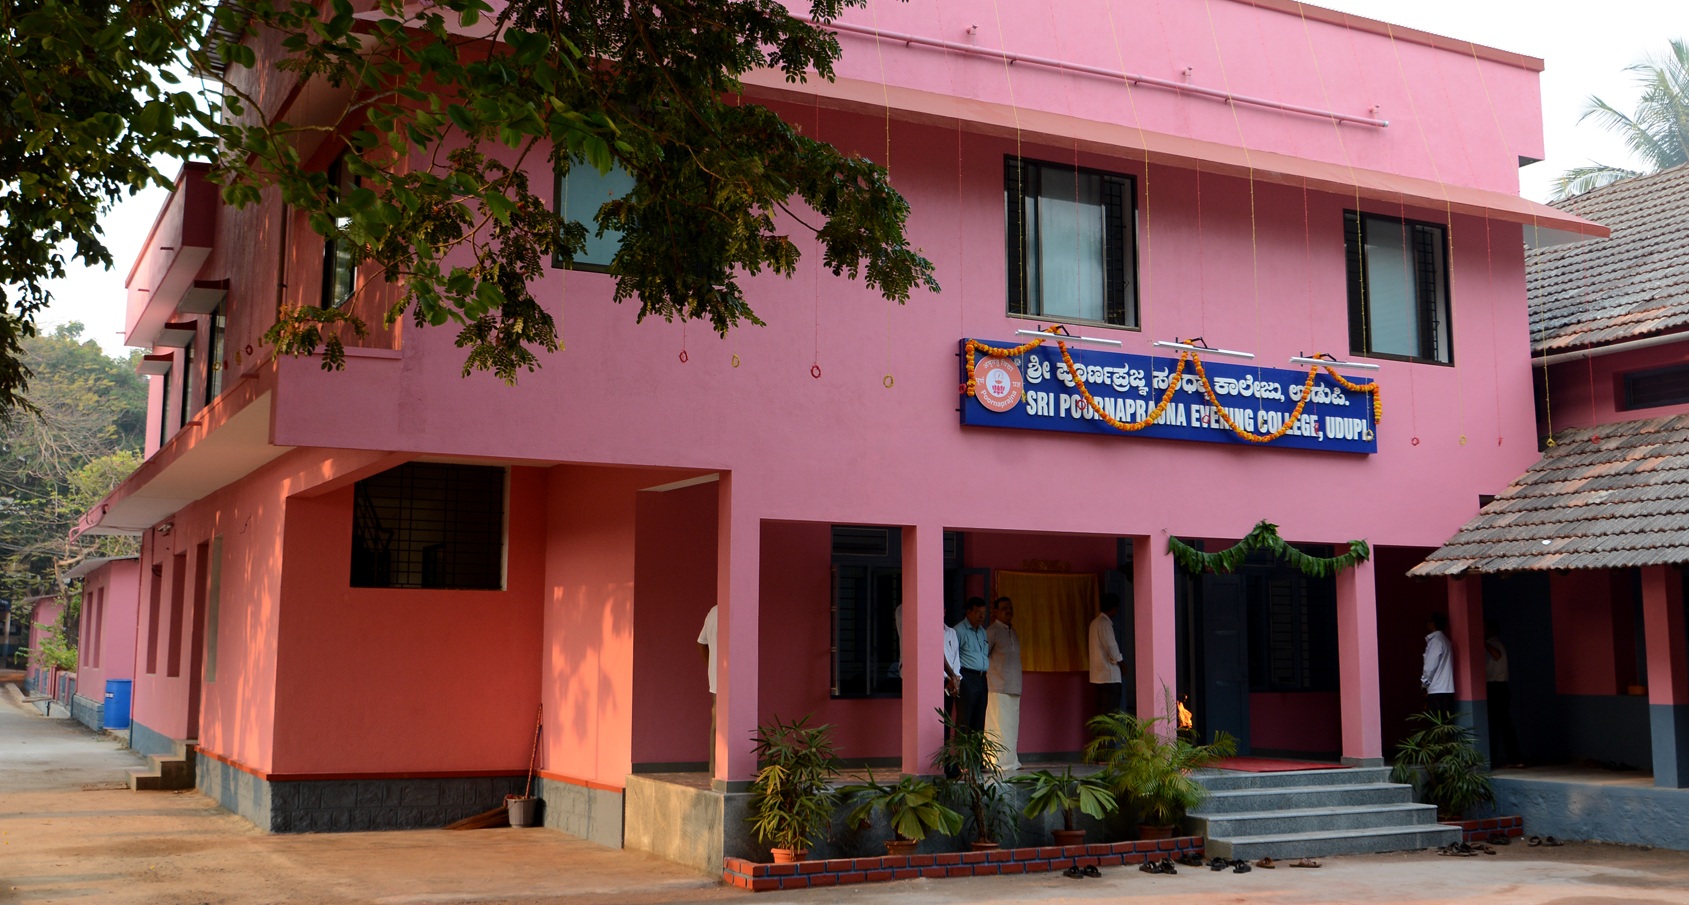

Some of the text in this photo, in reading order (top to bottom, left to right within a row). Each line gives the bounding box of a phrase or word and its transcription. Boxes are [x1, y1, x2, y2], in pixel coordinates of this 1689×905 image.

[981, 390, 1017, 408] Poornaprajna
[1026, 354, 1051, 384] ಶ್ರೀ
[1214, 374, 1285, 403] ಕಾಲೇಜು,
[1289, 382, 1350, 406] ಉಡುಪಿ.
[1026, 391, 1055, 417] SRI
[1191, 404, 1254, 432] EVENING
[1257, 410, 1323, 441] COLLEGE,
